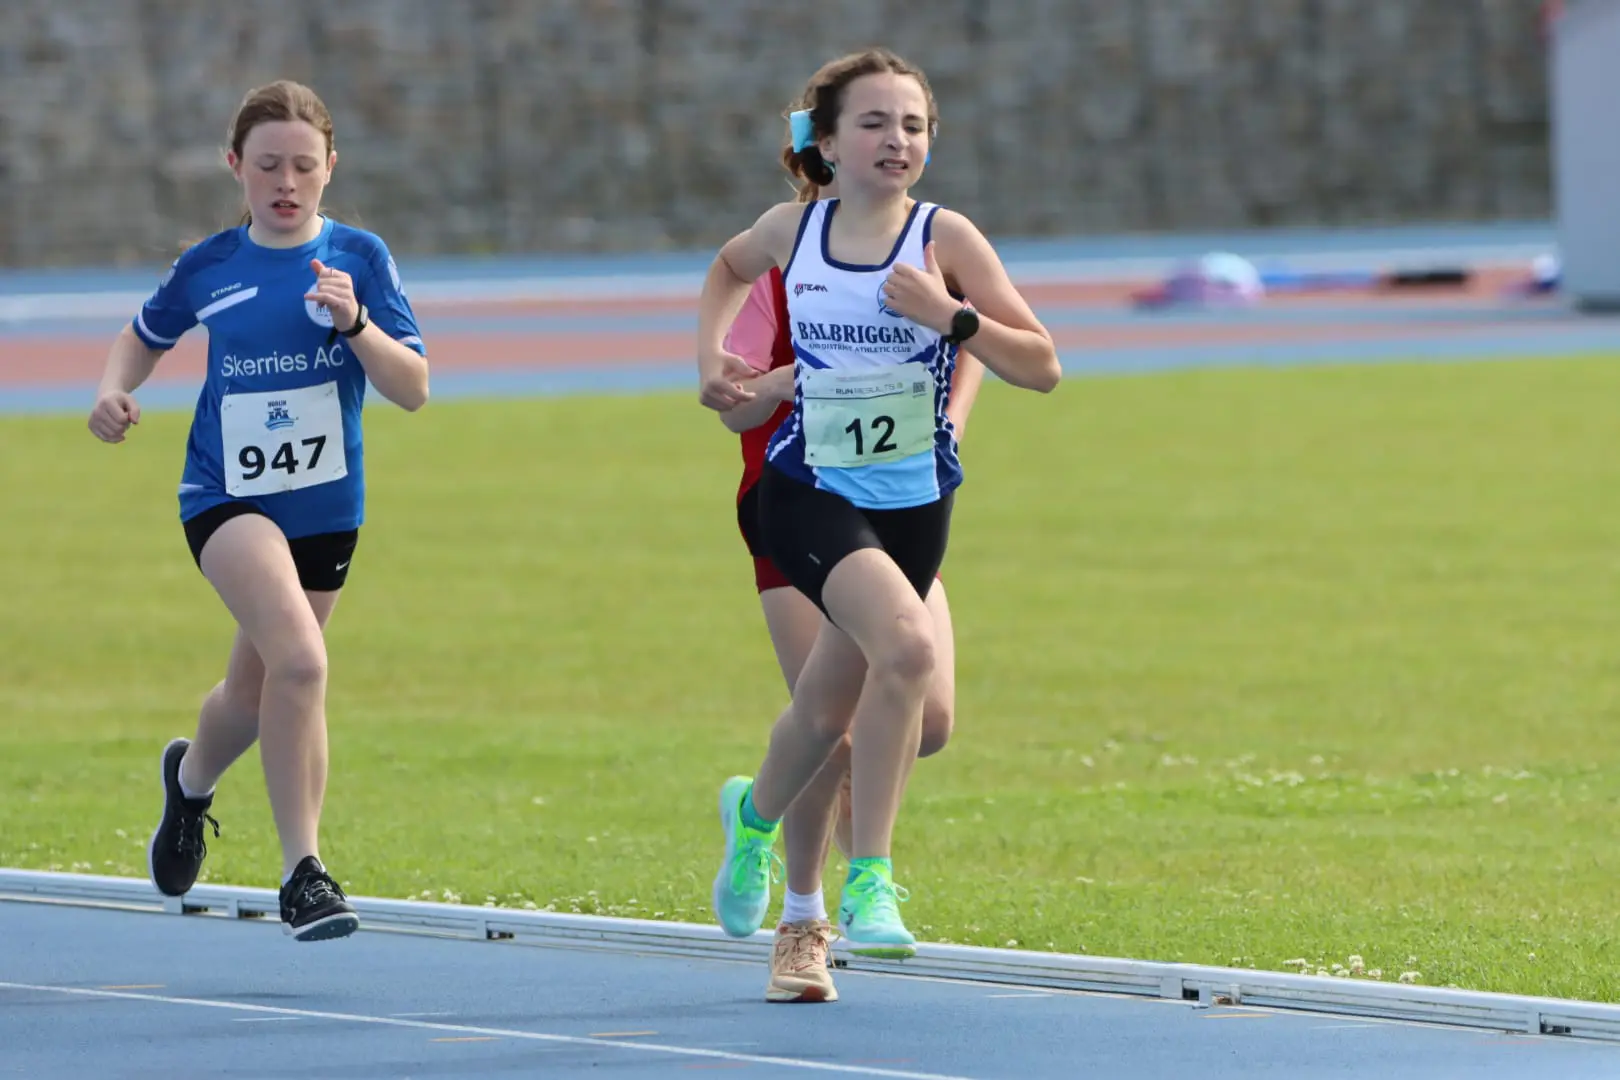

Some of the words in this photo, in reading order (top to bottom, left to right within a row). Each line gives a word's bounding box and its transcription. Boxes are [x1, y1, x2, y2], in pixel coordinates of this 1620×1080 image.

[797, 321, 916, 344] BALBRIGGAN
[221, 350, 308, 377] Skerries
[313, 343, 344, 370] AC
[855, 346, 890, 354] ATHLETIC
[845, 415, 897, 455] 12
[238, 435, 326, 480] 947
